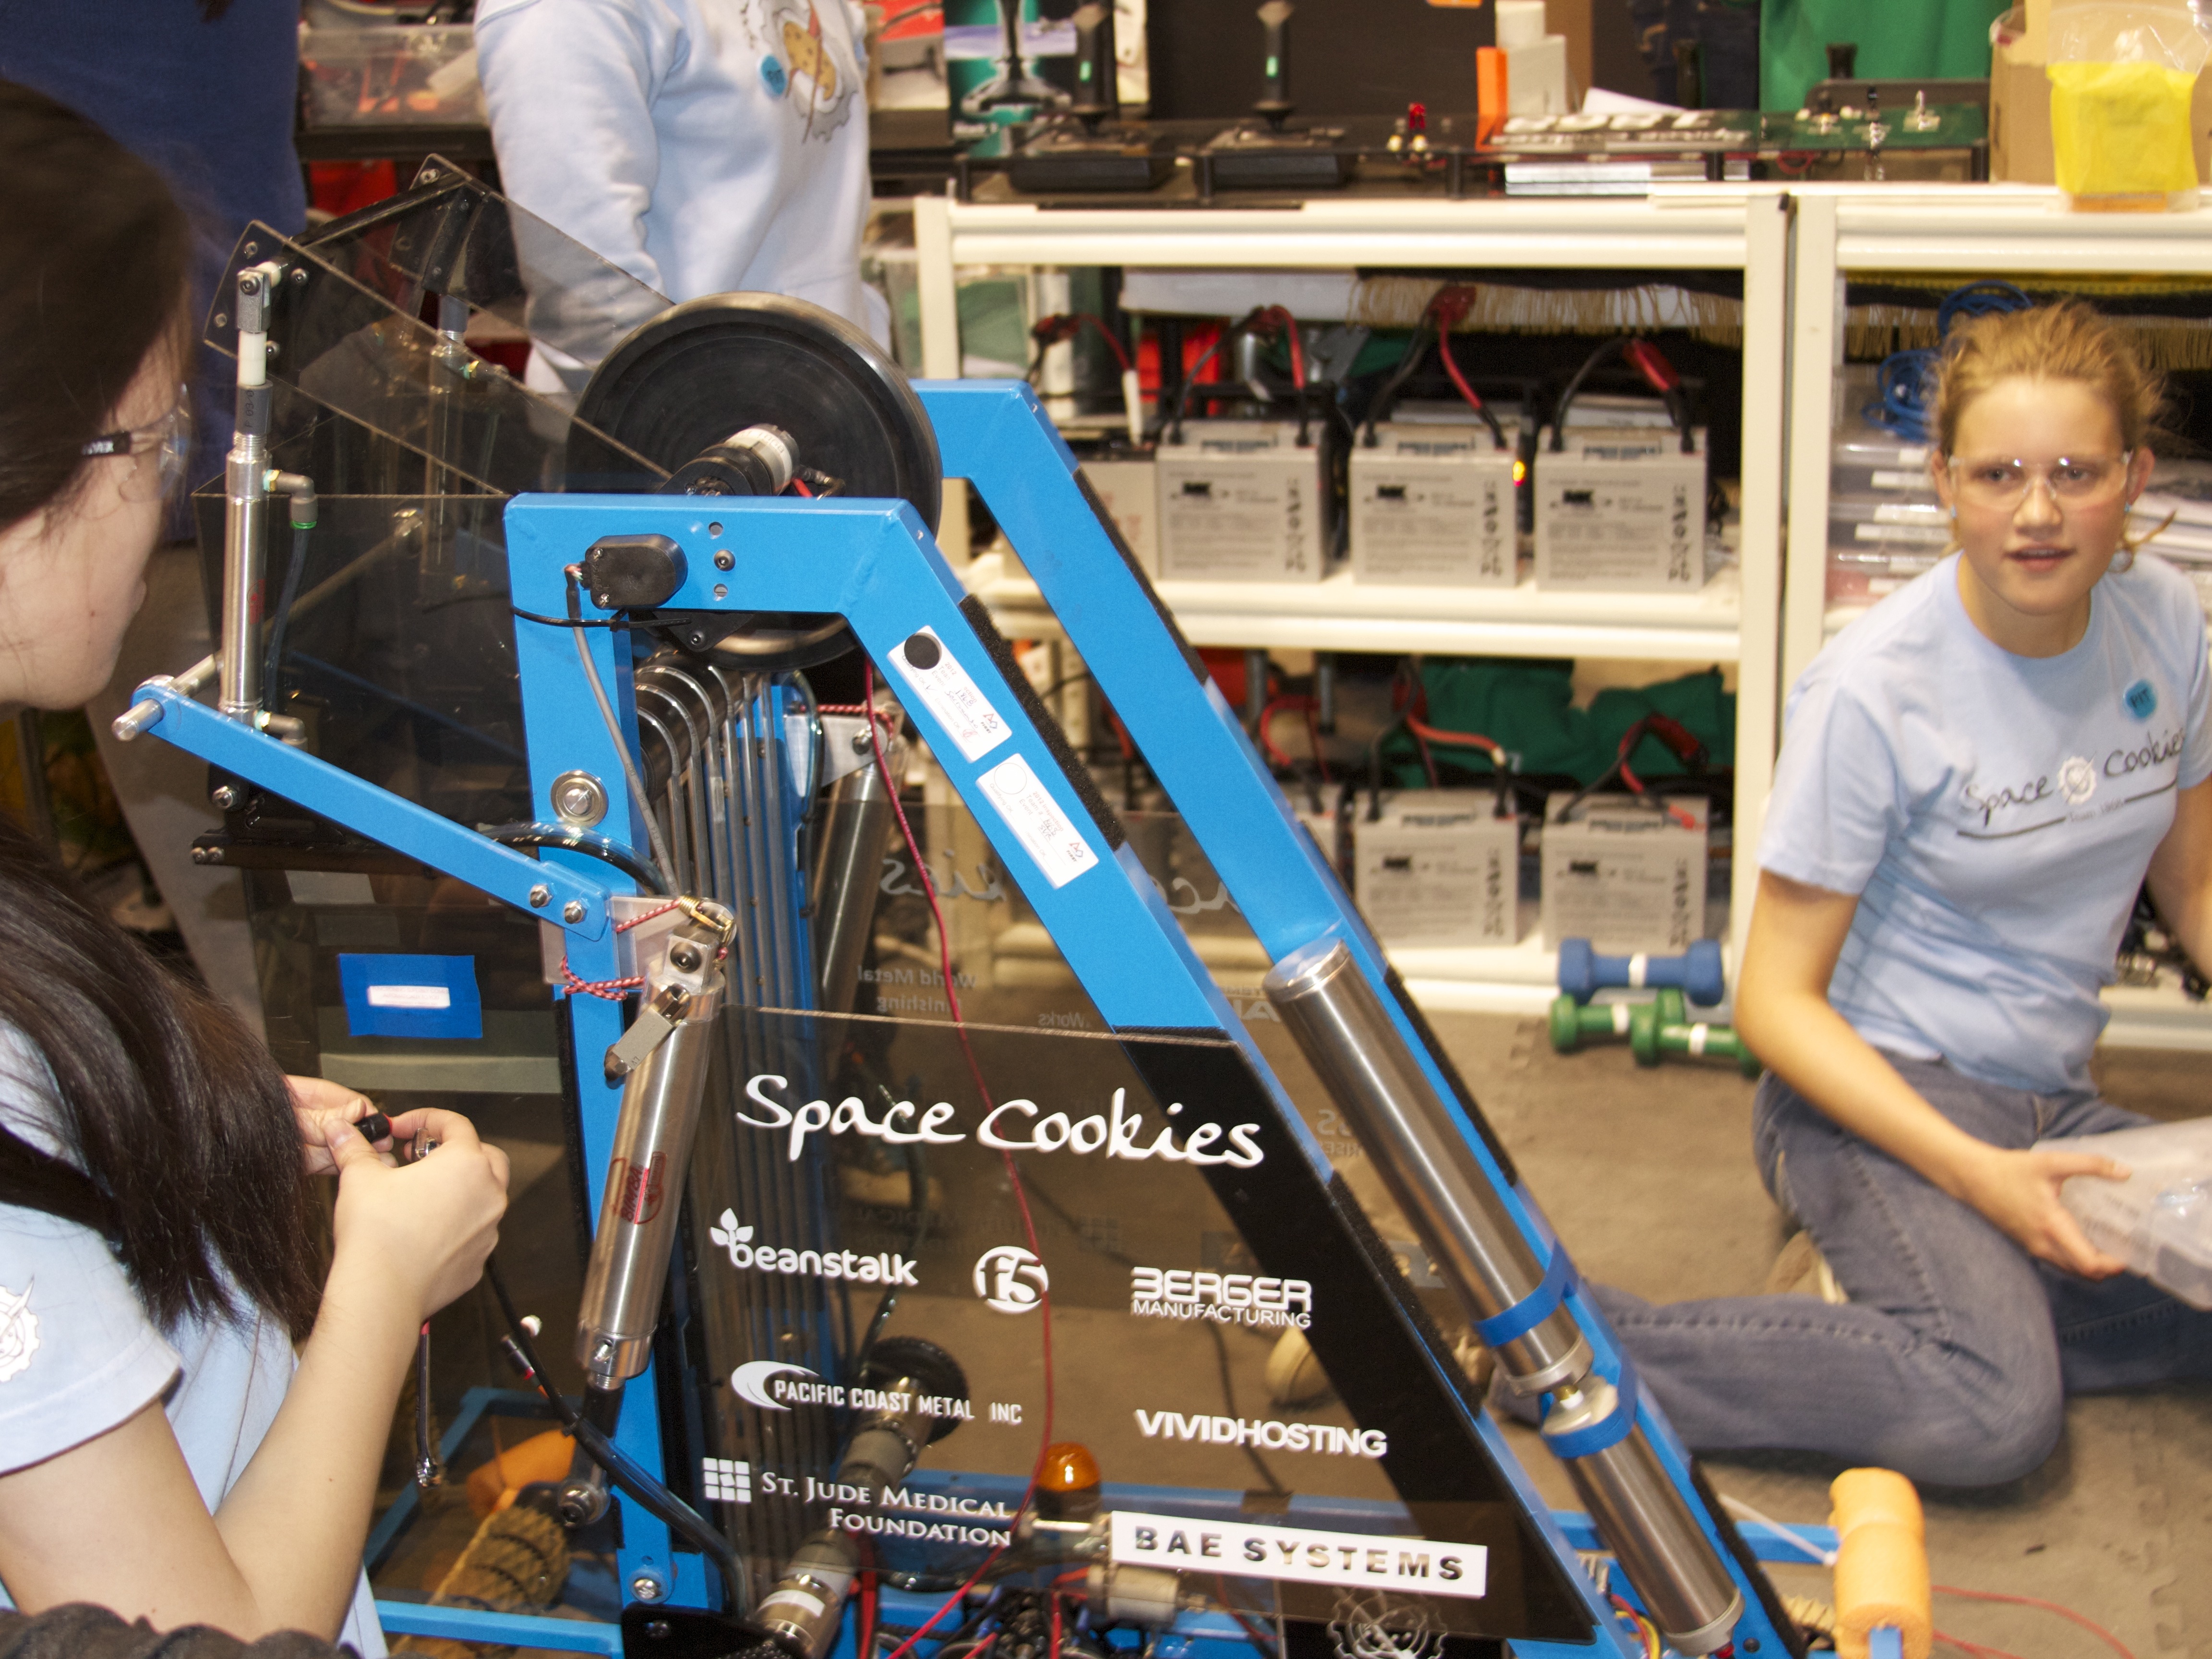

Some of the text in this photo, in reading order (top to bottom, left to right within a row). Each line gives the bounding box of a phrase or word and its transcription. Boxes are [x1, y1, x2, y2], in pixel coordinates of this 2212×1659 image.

[901, 654, 927, 685] Qualifying OK
[945, 661, 957, 676] 2012
[952, 721, 962, 730] OK
[980, 721, 992, 735] FIRST
[988, 782, 1014, 813] Qualifying OK
[1019, 798, 1034, 816] Event
[1025, 794, 1040, 812] Team
[1032, 791, 1065, 832] 2012 Inspection
[1963, 775, 2053, 829] Space
[1039, 849, 1047, 857] OK
[1066, 849, 1077, 863] FIRST
[736, 1074, 1264, 1168] Space Cookies
[730, 1238, 919, 1286] beanstalk
[1131, 1266, 1312, 1312] BERGER
[1131, 1298, 1311, 1329] MANUFACTURING
[773, 1379, 1022, 1425] PACIFIC COAST METAL INC
[1134, 1408, 1388, 1458] VIVIDHOSTING
[1135, 1526, 1464, 1581] BAE SYSTEMS
